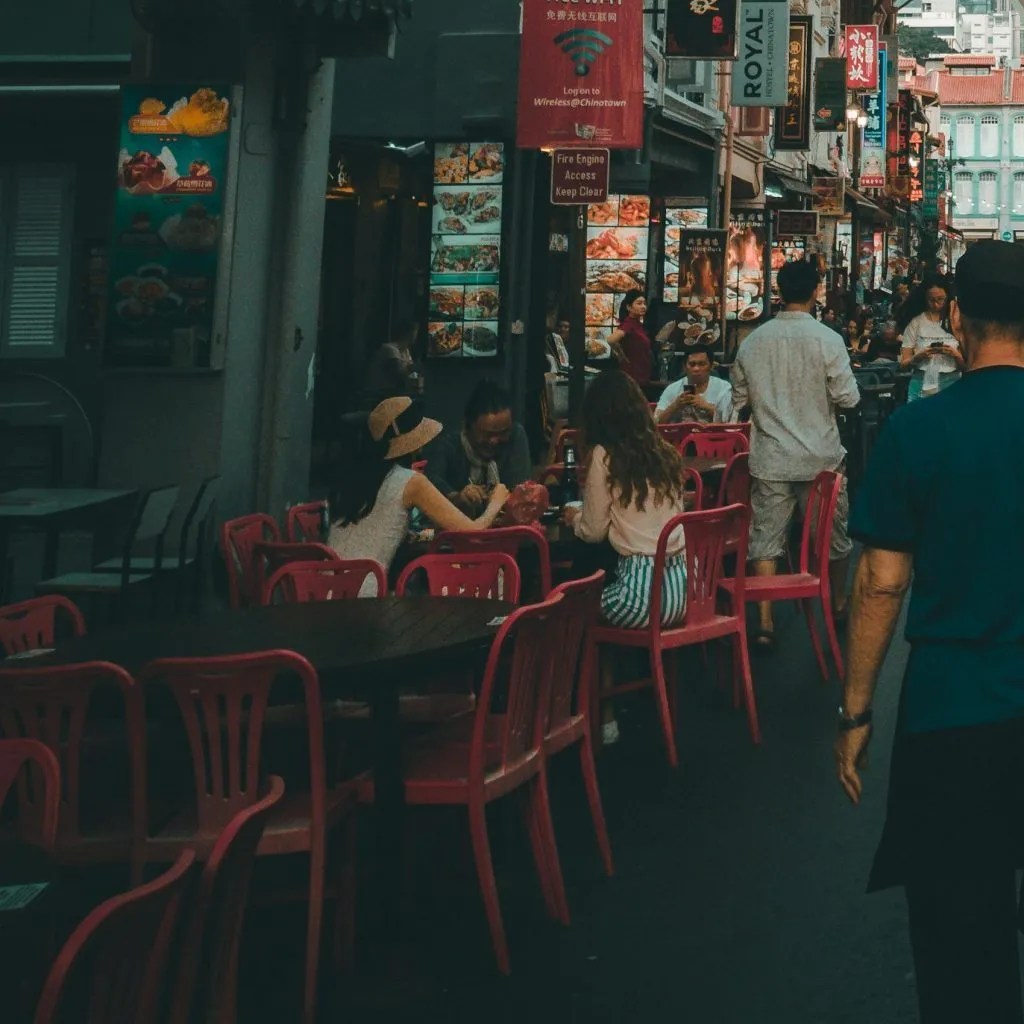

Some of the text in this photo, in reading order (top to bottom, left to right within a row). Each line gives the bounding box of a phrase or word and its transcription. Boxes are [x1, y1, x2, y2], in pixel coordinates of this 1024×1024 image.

[766, 8, 776, 61] CHINATOWN
[743, 8, 764, 98] ROYAL
[563, 87, 578, 96] Log
[592, 87, 600, 95] to
[533, 98, 627, 107] Wireless@Chinatown
[557, 154, 605, 166] Fire Engine
[565, 170, 597, 180] Access
[555, 186, 604, 198] Keep Clear
